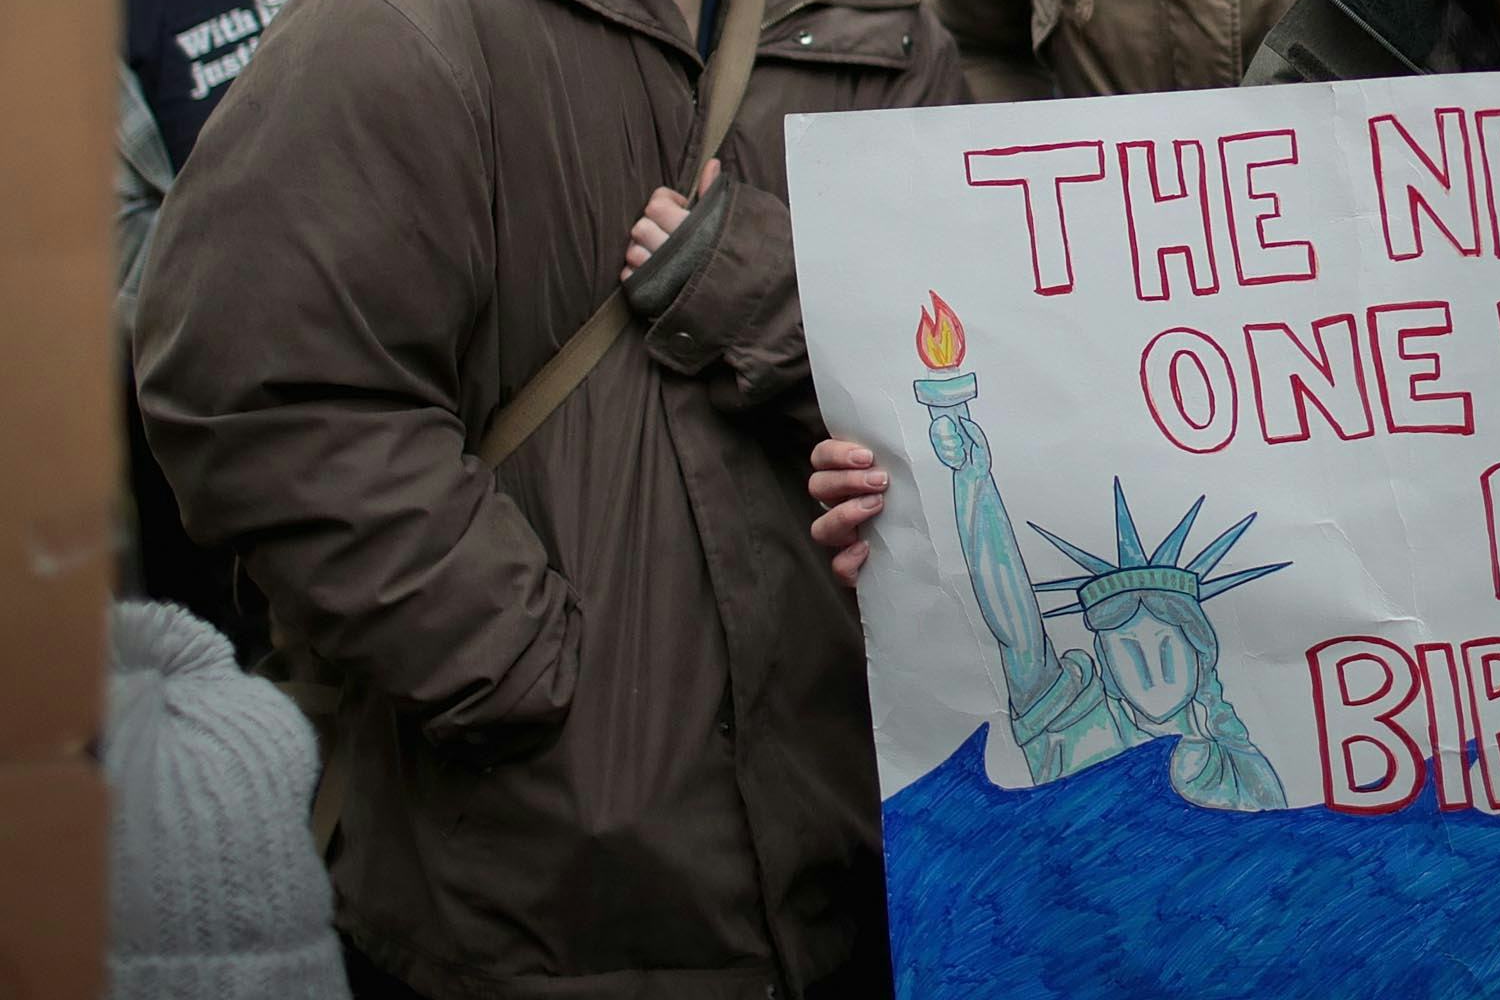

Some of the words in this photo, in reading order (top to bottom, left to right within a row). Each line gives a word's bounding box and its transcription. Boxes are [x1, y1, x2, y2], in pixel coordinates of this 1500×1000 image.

[176, 8, 263, 61] With
[964, 128, 1319, 301] THE
[1140, 300, 1476, 454] ONE
